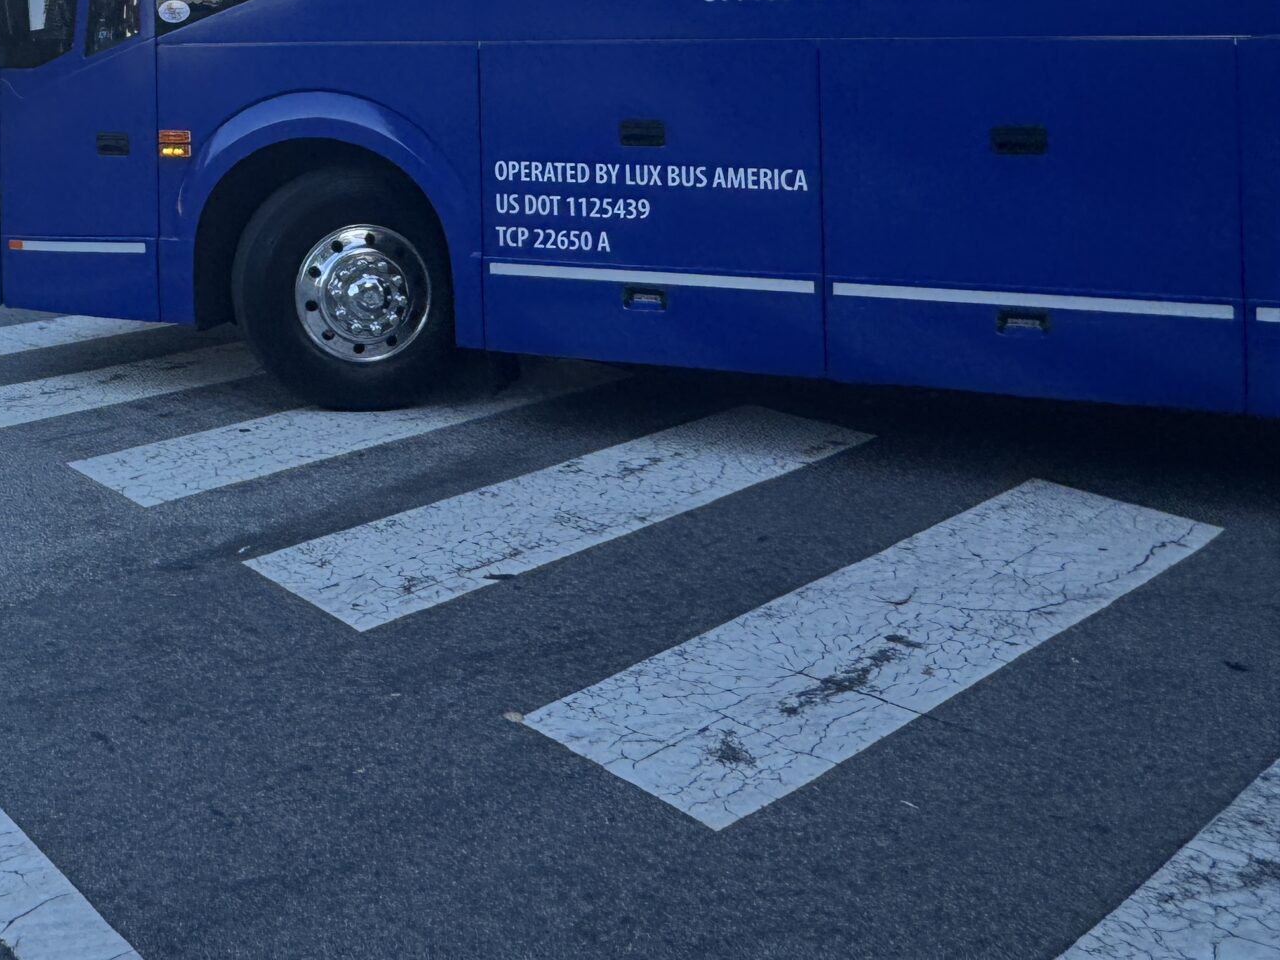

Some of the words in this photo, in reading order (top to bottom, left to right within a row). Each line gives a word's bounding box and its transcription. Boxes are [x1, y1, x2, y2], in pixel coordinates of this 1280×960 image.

[494, 160, 590, 183] OPERATED
[595, 163, 620, 184] BY
[625, 164, 663, 186] LUX
[667, 165, 708, 188] BUS
[712, 167, 808, 191] AMERICA
[495, 193, 520, 214] US
[524, 194, 561, 216] DOT
[566, 196, 651, 219] 1125439
[495, 226, 529, 248] TCP
[533, 228, 593, 251] 22650
[597, 231, 611, 252] A
